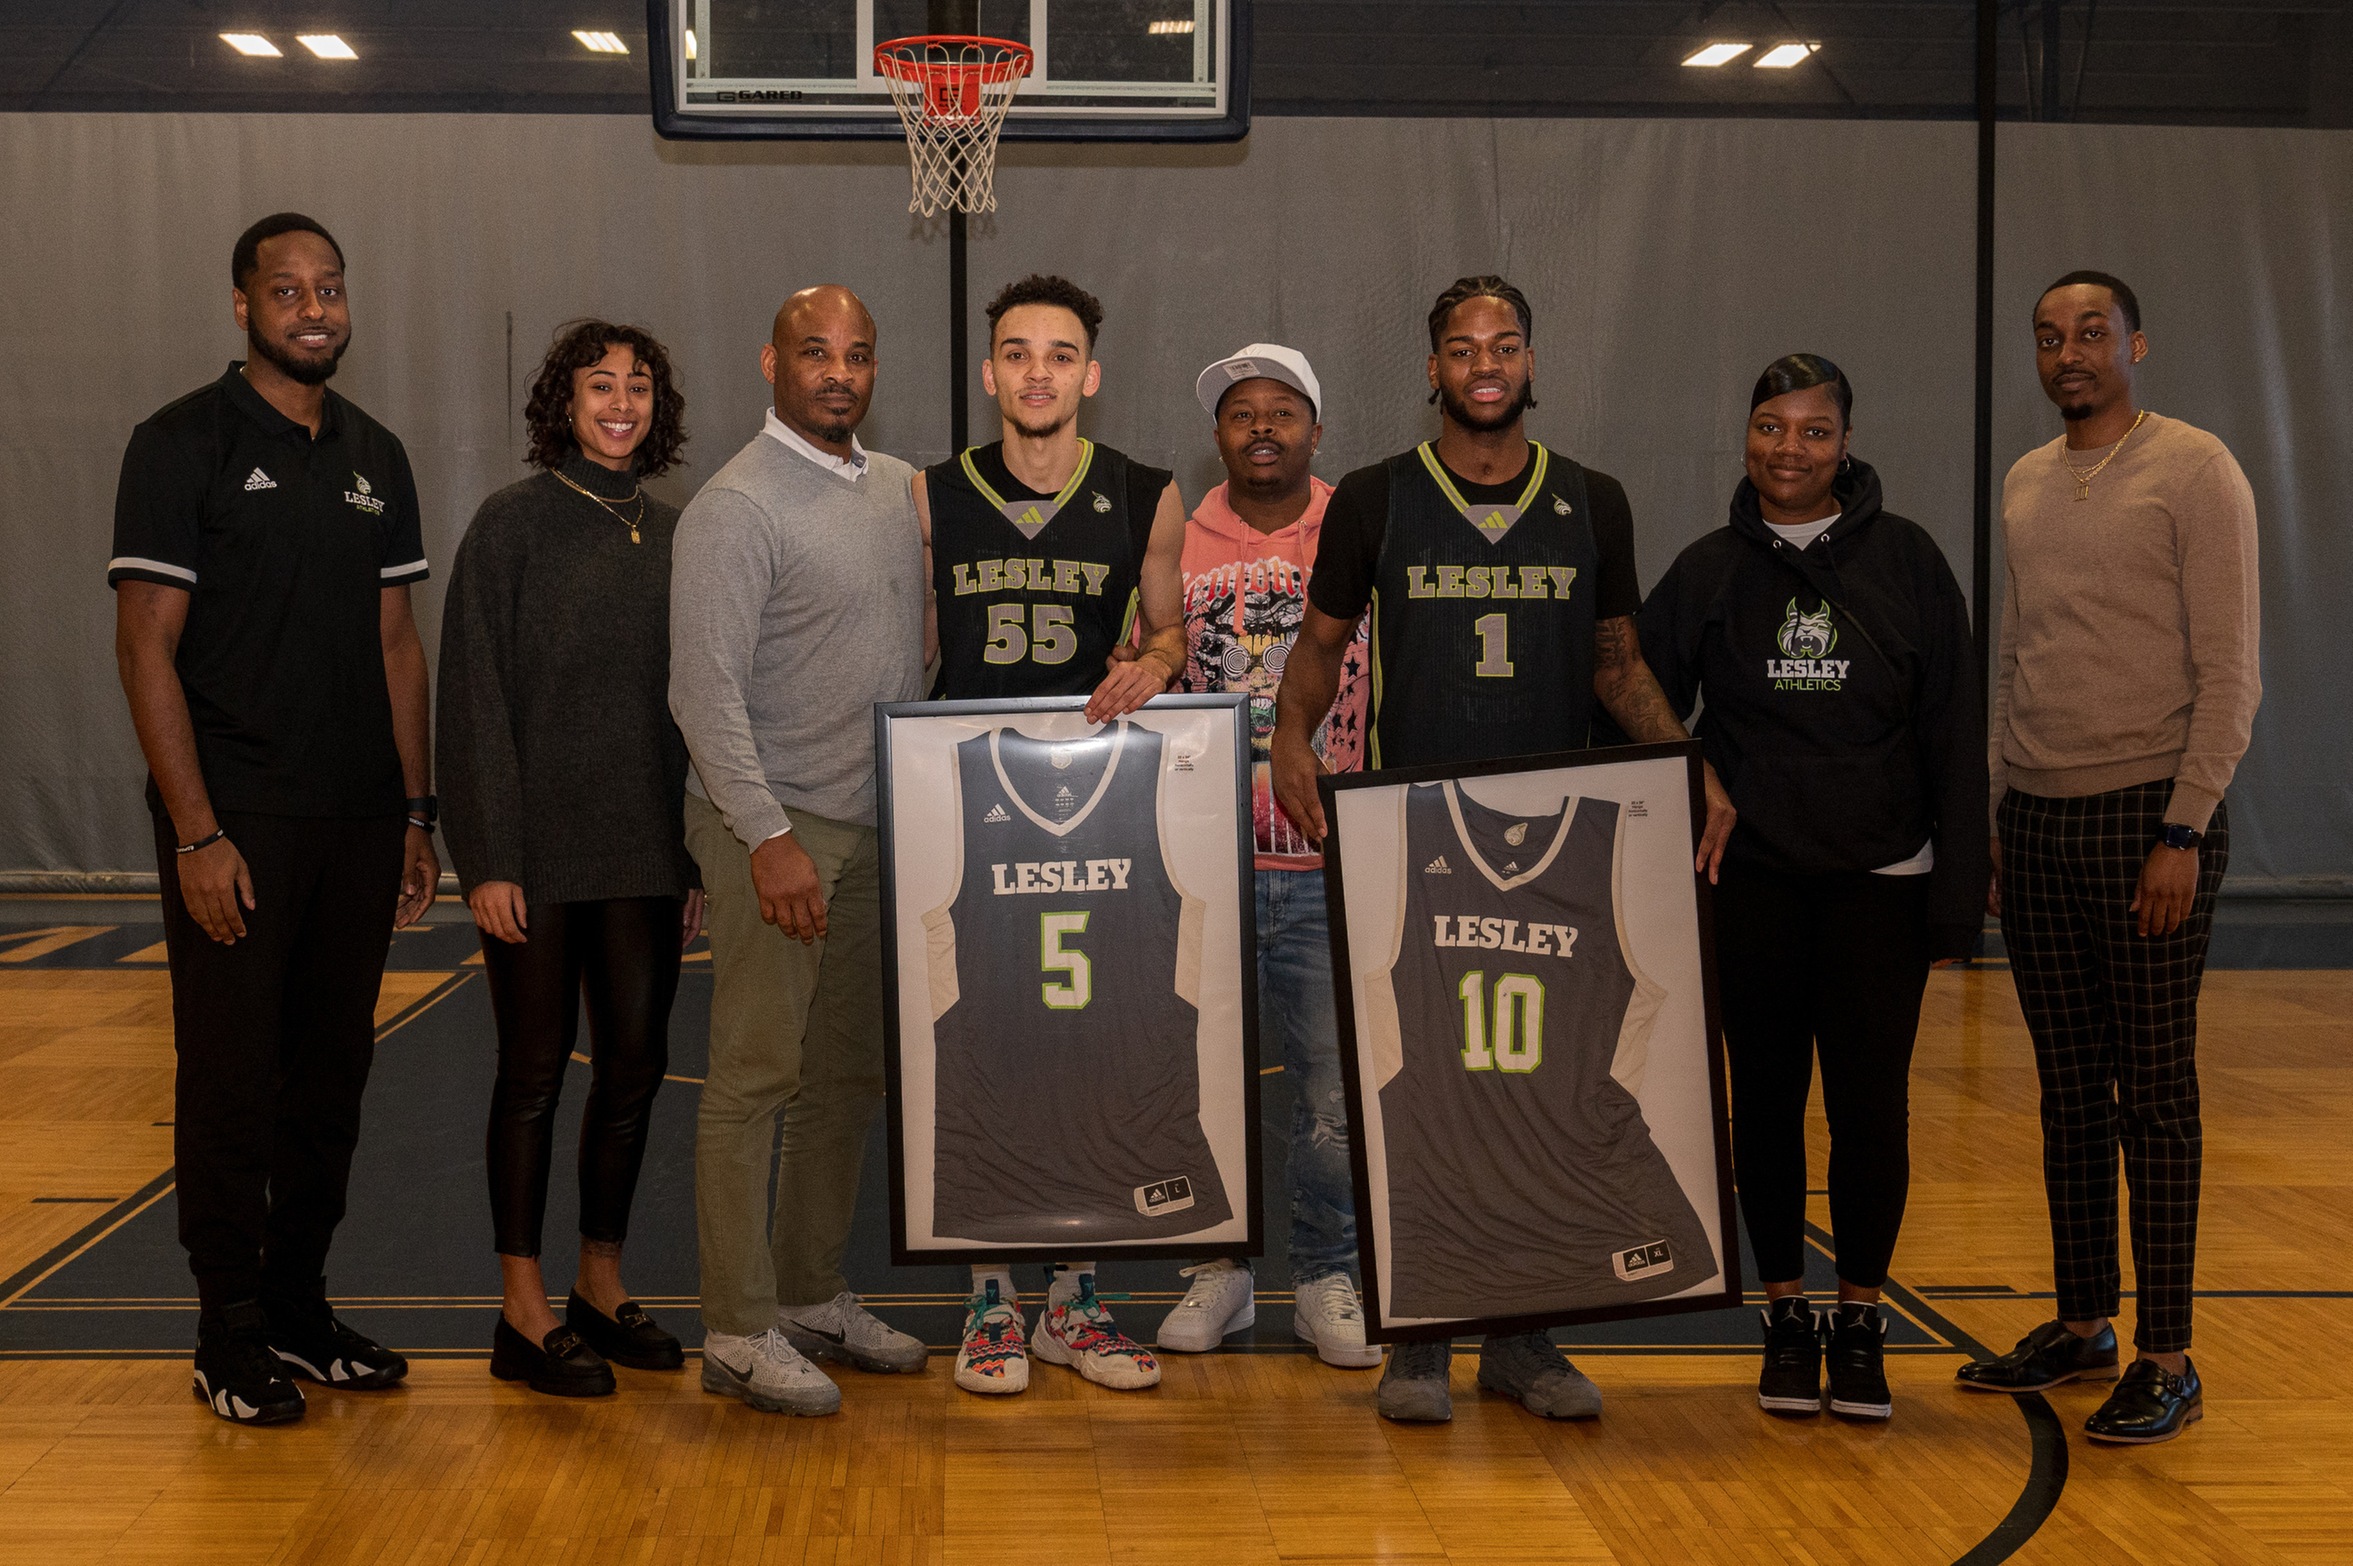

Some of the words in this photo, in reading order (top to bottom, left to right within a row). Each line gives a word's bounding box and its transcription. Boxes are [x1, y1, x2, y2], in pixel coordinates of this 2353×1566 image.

[738, 90, 802, 100] GARED
[244, 480, 278, 491] adidas
[344, 491, 385, 512] LESLEY
[953, 558, 1110, 596] LESLEY
[1407, 565, 1577, 599] LESLEY
[984, 603, 1077, 665] 55
[1475, 613, 1514, 677] 1
[1767, 659, 1850, 679] LESLEY
[1774, 679, 1841, 691] ATHLETICS
[984, 815, 1011, 823] adidas
[991, 858, 1132, 895] LESLEY
[1424, 867, 1452, 875] adidas
[1434, 915, 1579, 958] LESLEY
[1041, 911, 1092, 1010] 5
[1459, 970, 1545, 1074] 10
[1653, 1249, 1664, 1257] XL
